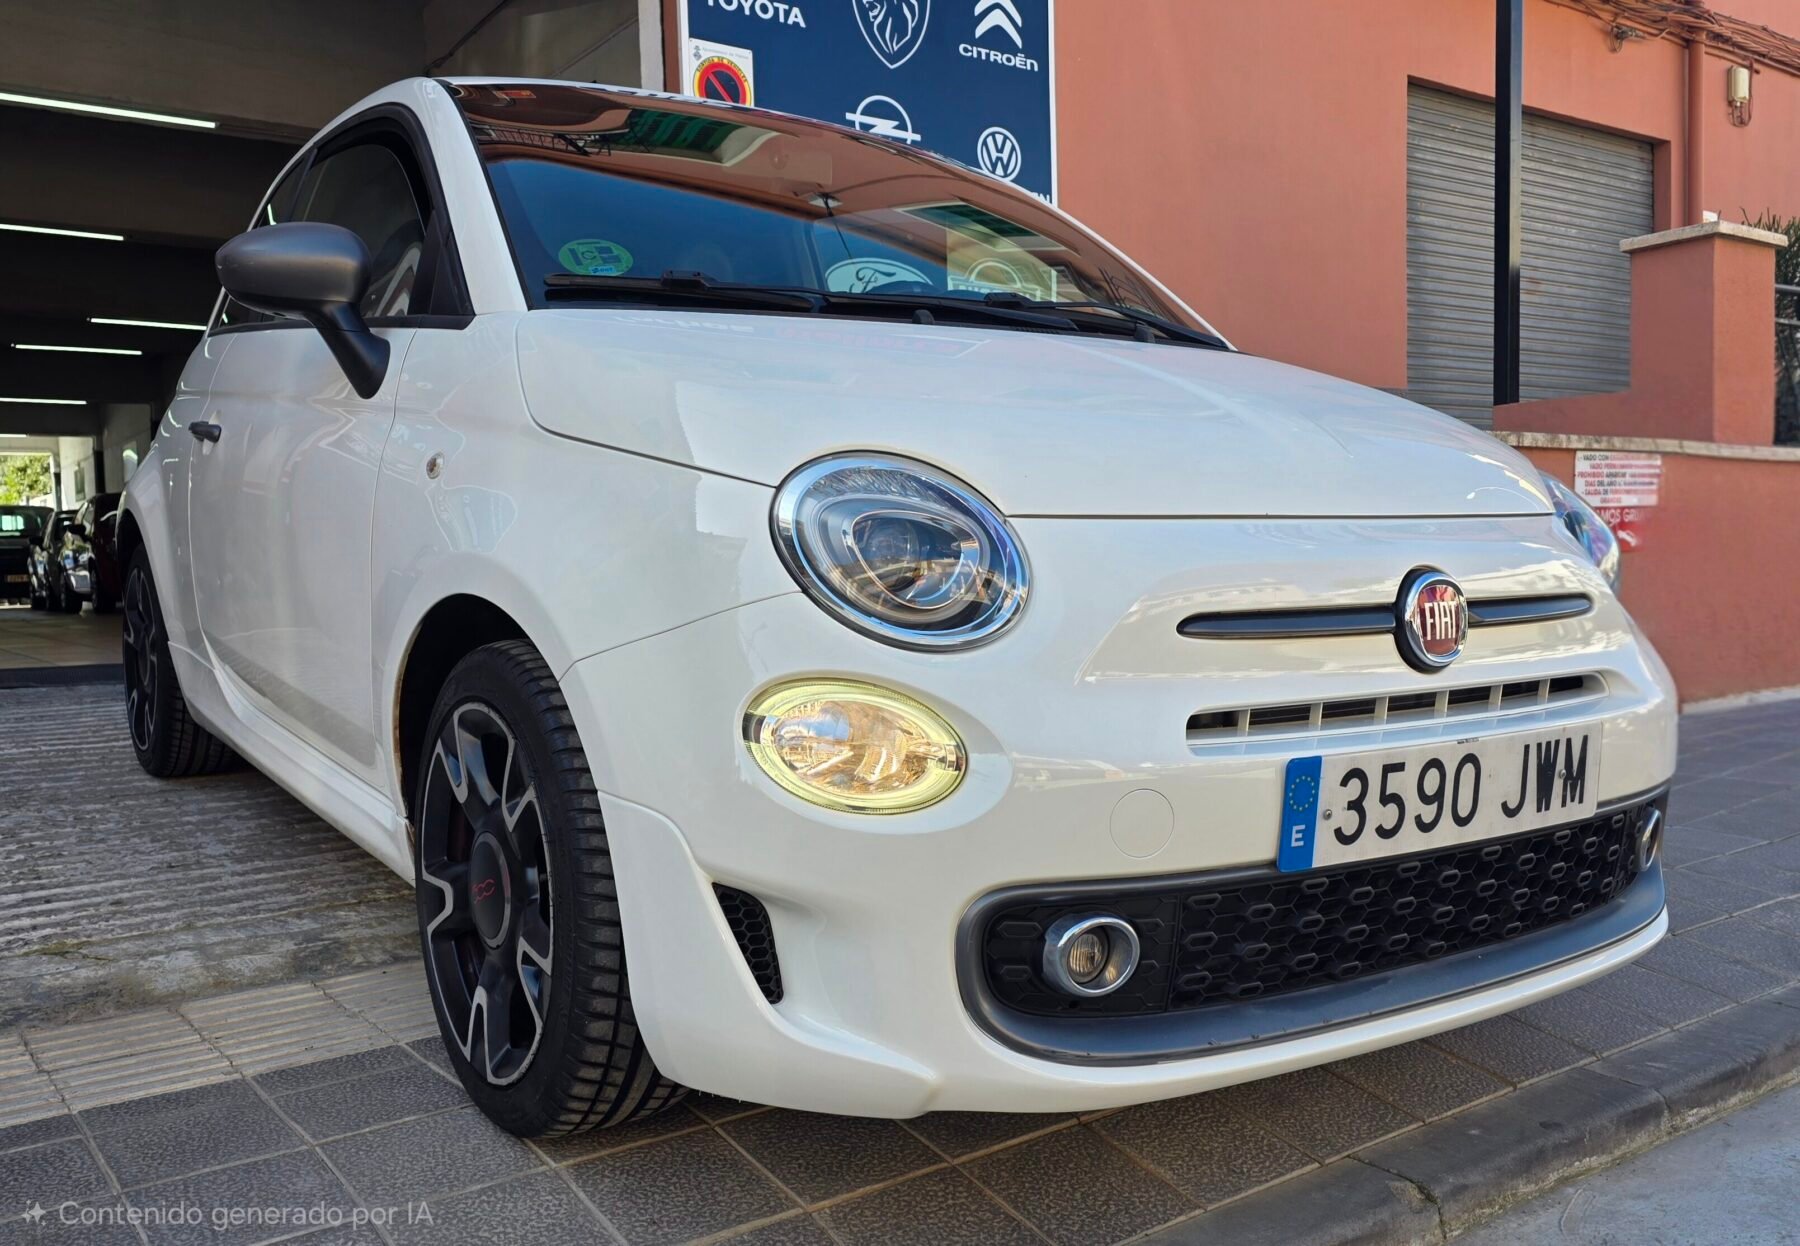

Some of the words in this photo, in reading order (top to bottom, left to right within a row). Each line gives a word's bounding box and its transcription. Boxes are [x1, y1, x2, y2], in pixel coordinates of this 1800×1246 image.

[958, 43, 1039, 72] CITROËN
[1424, 601, 1458, 640] FIAT
[1333, 752, 1482, 846] 3590
[1500, 734, 1589, 819] JWM
[1290, 824, 1306, 847] E
